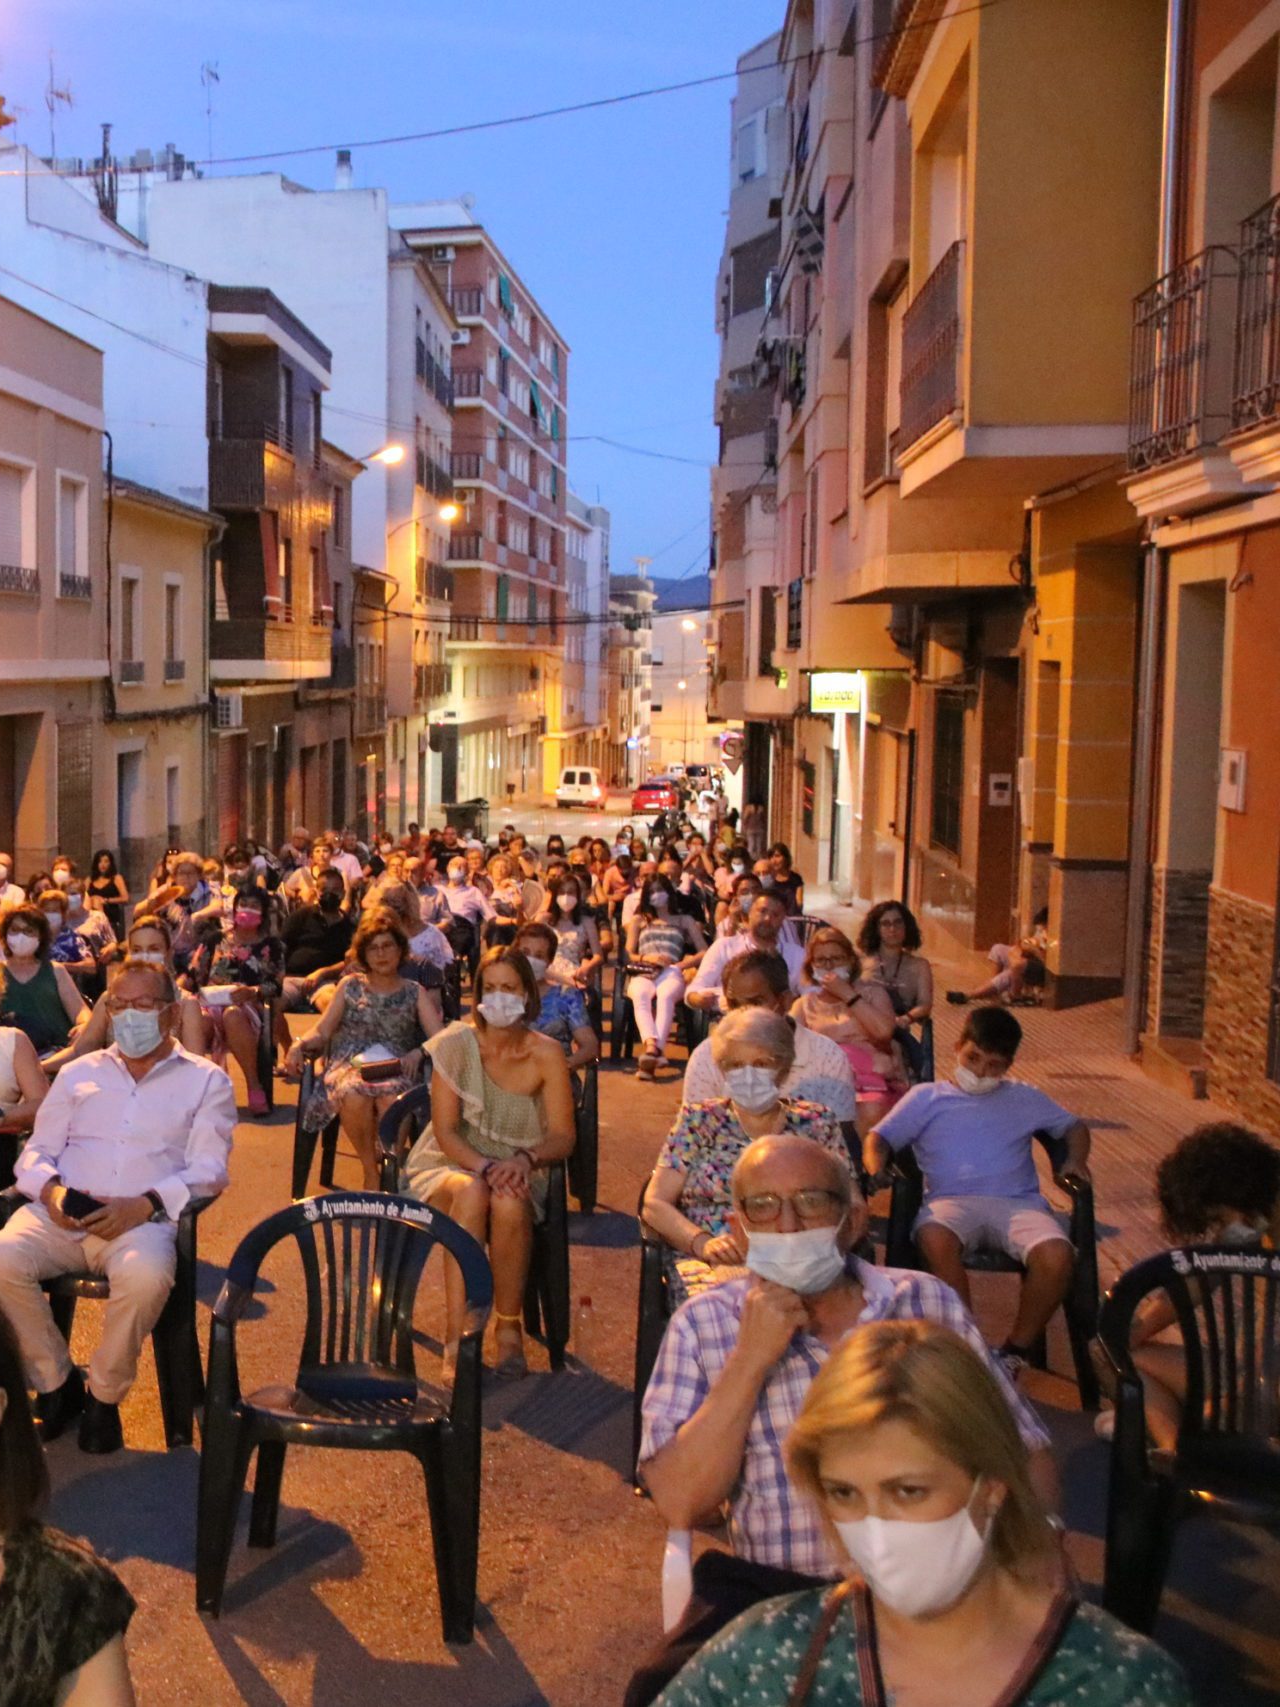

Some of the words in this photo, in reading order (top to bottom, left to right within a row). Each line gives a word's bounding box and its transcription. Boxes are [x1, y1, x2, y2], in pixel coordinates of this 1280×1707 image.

[322, 1200, 385, 1218] Ayuntamiento
[387, 1202, 400, 1217] de
[401, 1204, 433, 1225] Jumilla
[1193, 1251, 1267, 1272] Ayuntamiento
